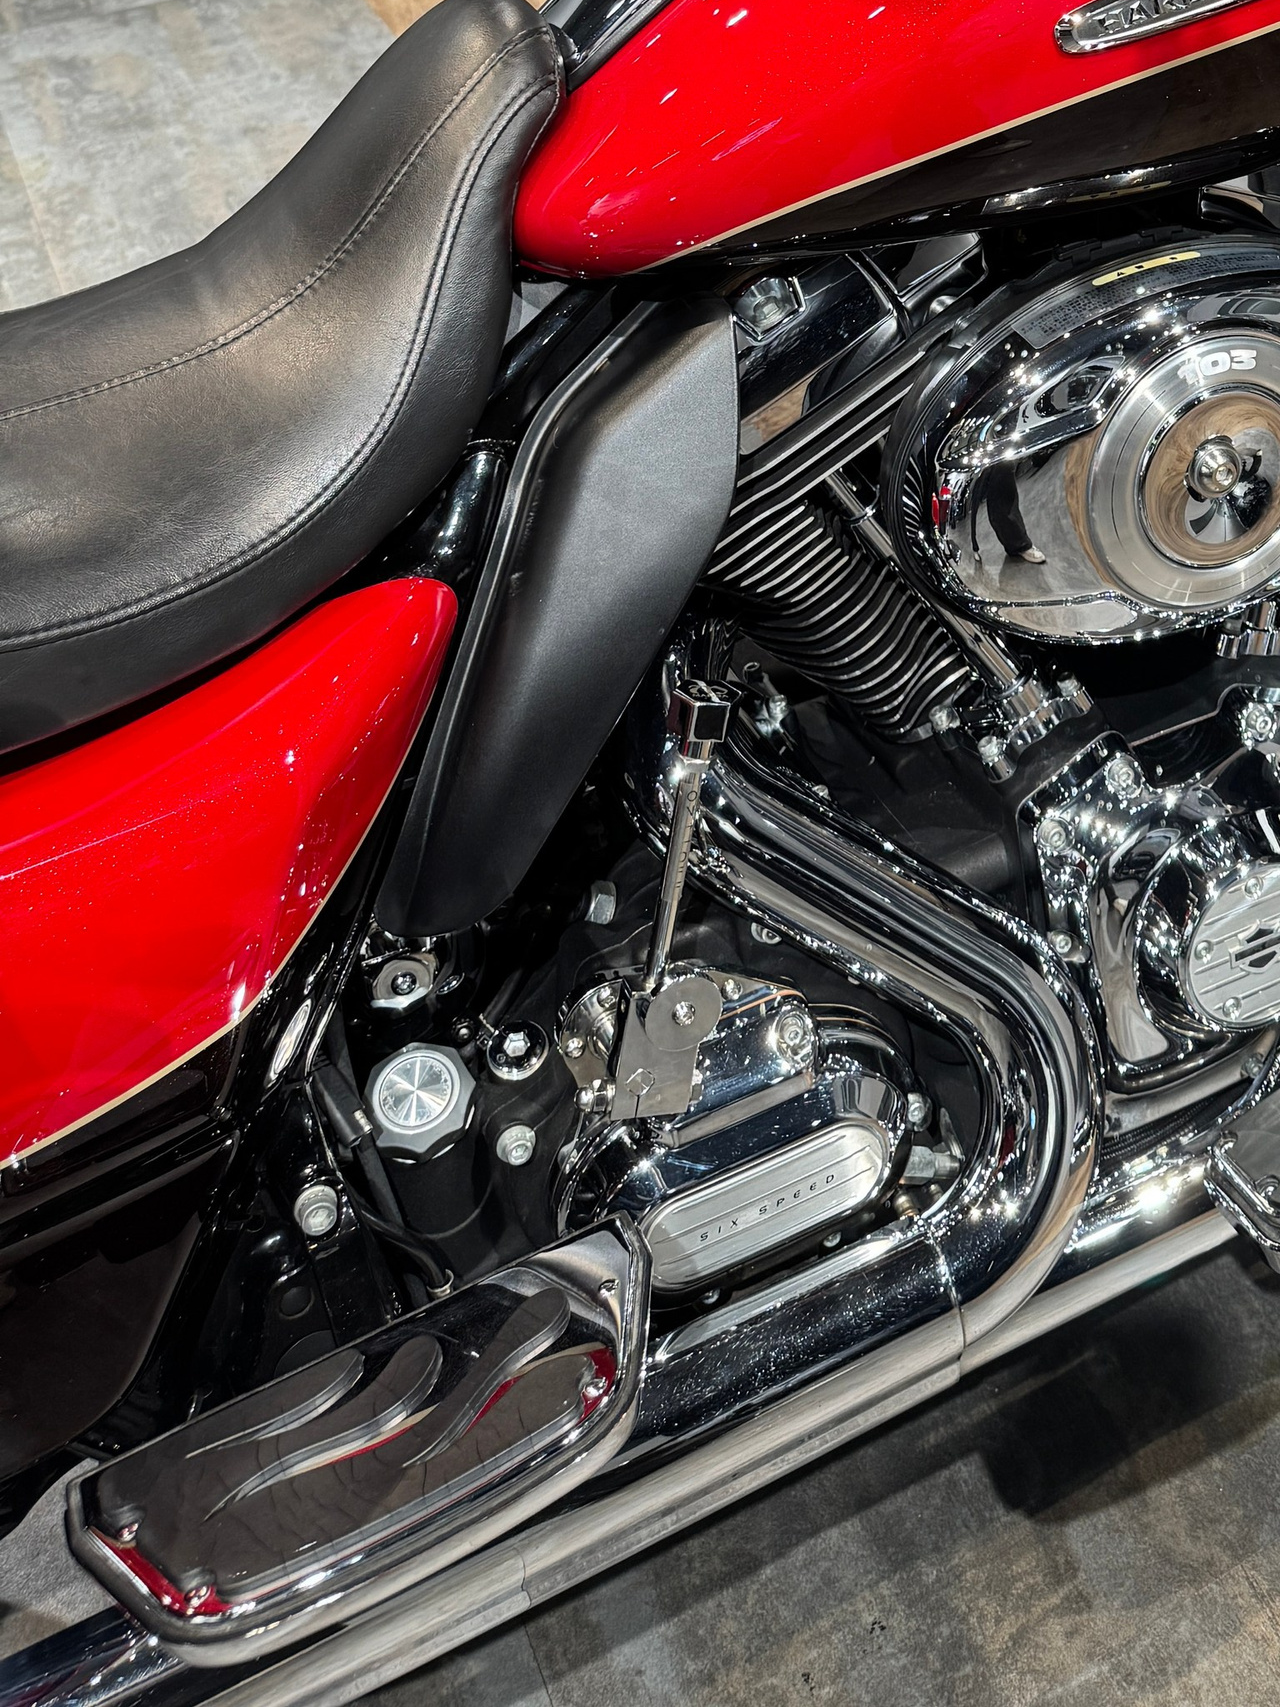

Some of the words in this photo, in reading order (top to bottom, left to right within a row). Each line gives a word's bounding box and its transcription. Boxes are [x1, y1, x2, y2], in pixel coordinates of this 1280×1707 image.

[1176, 347, 1258, 386] 103
[699, 1217, 740, 1243] SIX
[757, 1173, 836, 1217] SPEED
